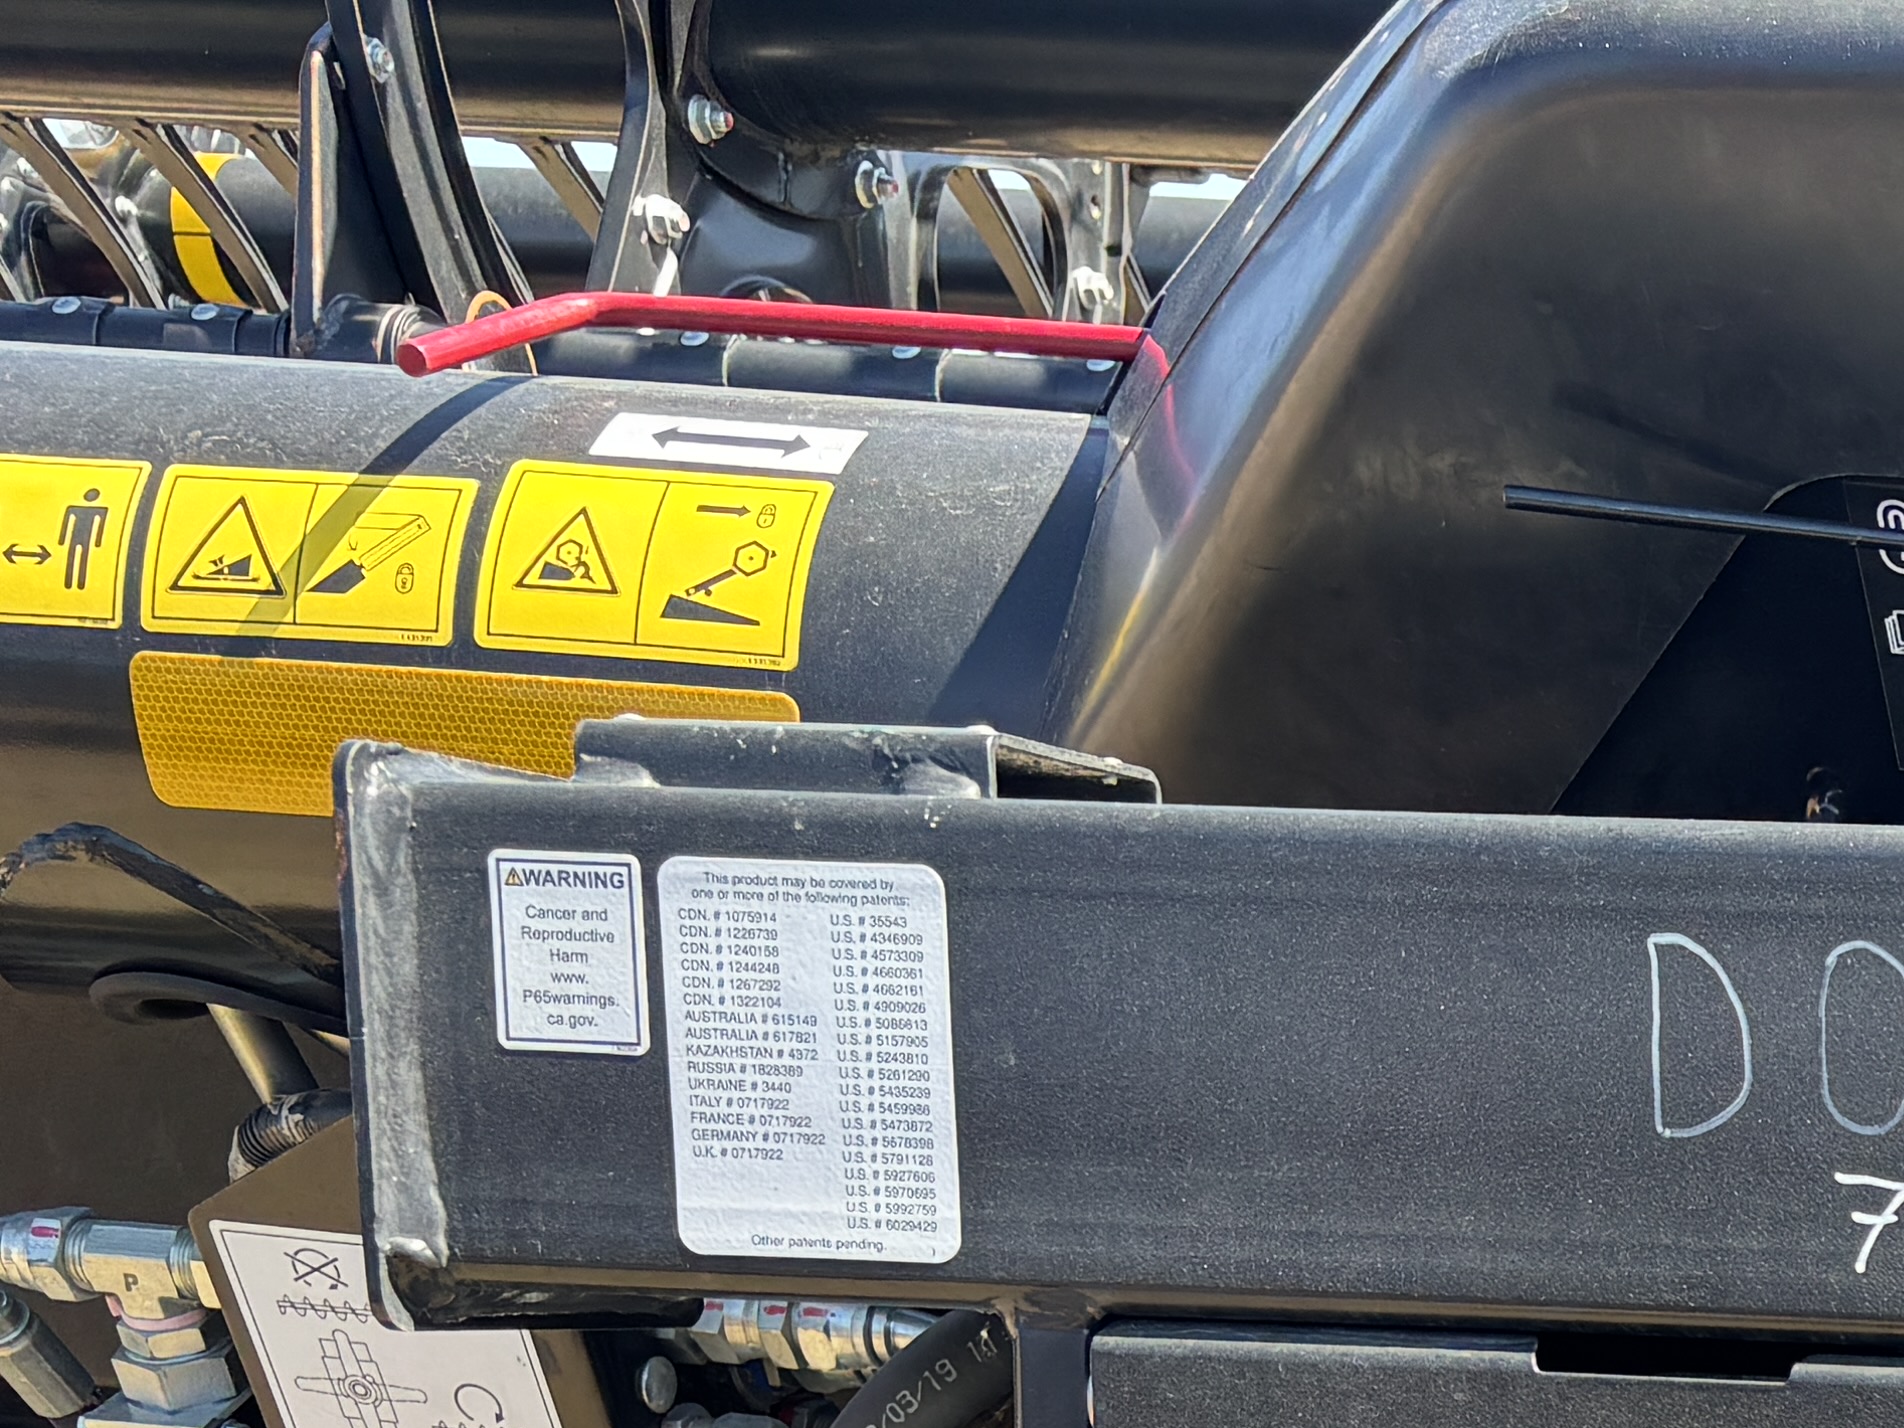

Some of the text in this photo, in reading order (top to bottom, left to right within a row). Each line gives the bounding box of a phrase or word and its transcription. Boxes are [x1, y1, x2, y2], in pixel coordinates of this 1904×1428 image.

[521, 868, 625, 890] WARNING
[704, 872, 894, 892] This product may be covered by
[691, 888, 713, 899] one
[718, 889, 729, 900] or
[734, 891, 763, 901] more
[768, 890, 779, 901] of
[783, 891, 801, 903] the
[804, 891, 857, 907] following
[525, 905, 608, 923] Cancer and
[678, 908, 710, 921] CDN.
[521, 925, 615, 946] Reproductive
[549, 947, 588, 965] Harm
[681, 958, 713, 972] CDN.
[550, 971, 589, 985] www.
[682, 976, 714, 989] CDN.
[683, 993, 714, 1006] CDN.
[685, 1010, 758, 1024] AUSTRALIA
[686, 1044, 773, 1059] KAZAKHSTAN
[688, 1077, 747, 1092] UKRAINE
[689, 1094, 722, 1108] ITALY
[690, 1111, 745, 1125] FRANCE
[691, 1128, 758, 1142] GERMANY
[692, 1145, 717, 1158] U.K.
[751, 1234, 888, 1254] Other patents pending.
[122, 1272, 139, 1292] P
